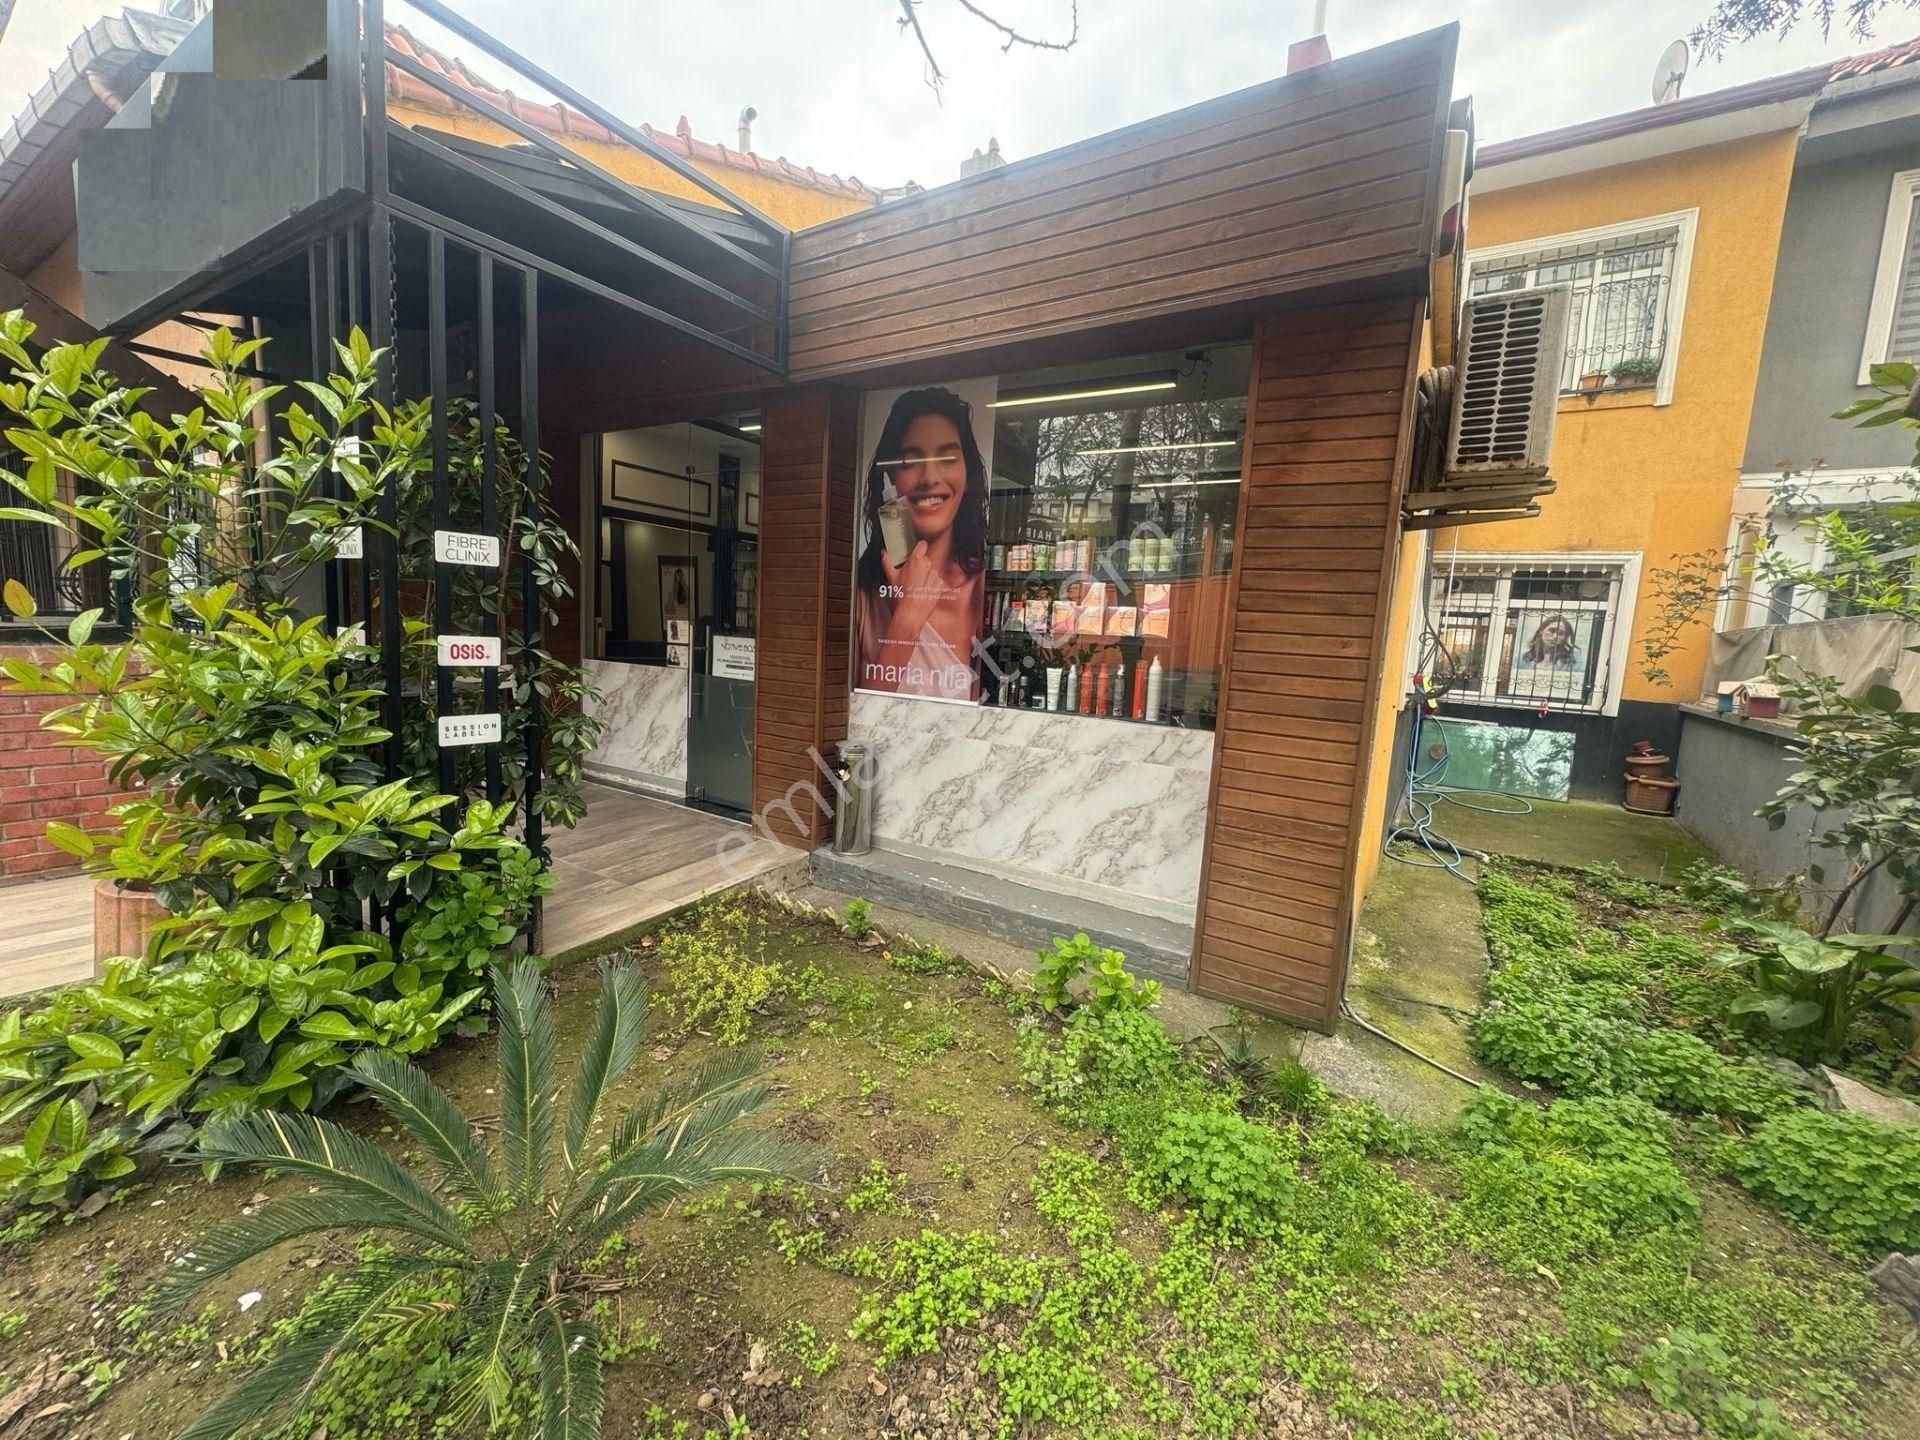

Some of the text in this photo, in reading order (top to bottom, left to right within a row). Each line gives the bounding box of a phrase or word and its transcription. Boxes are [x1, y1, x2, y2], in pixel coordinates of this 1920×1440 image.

[447, 534, 488, 550] FIBRE
[445, 548, 490, 563] CLINIX
[878, 584, 904, 598] 91%
[865, 662, 969, 690] maria nila
[444, 722, 497, 732] SESSION
